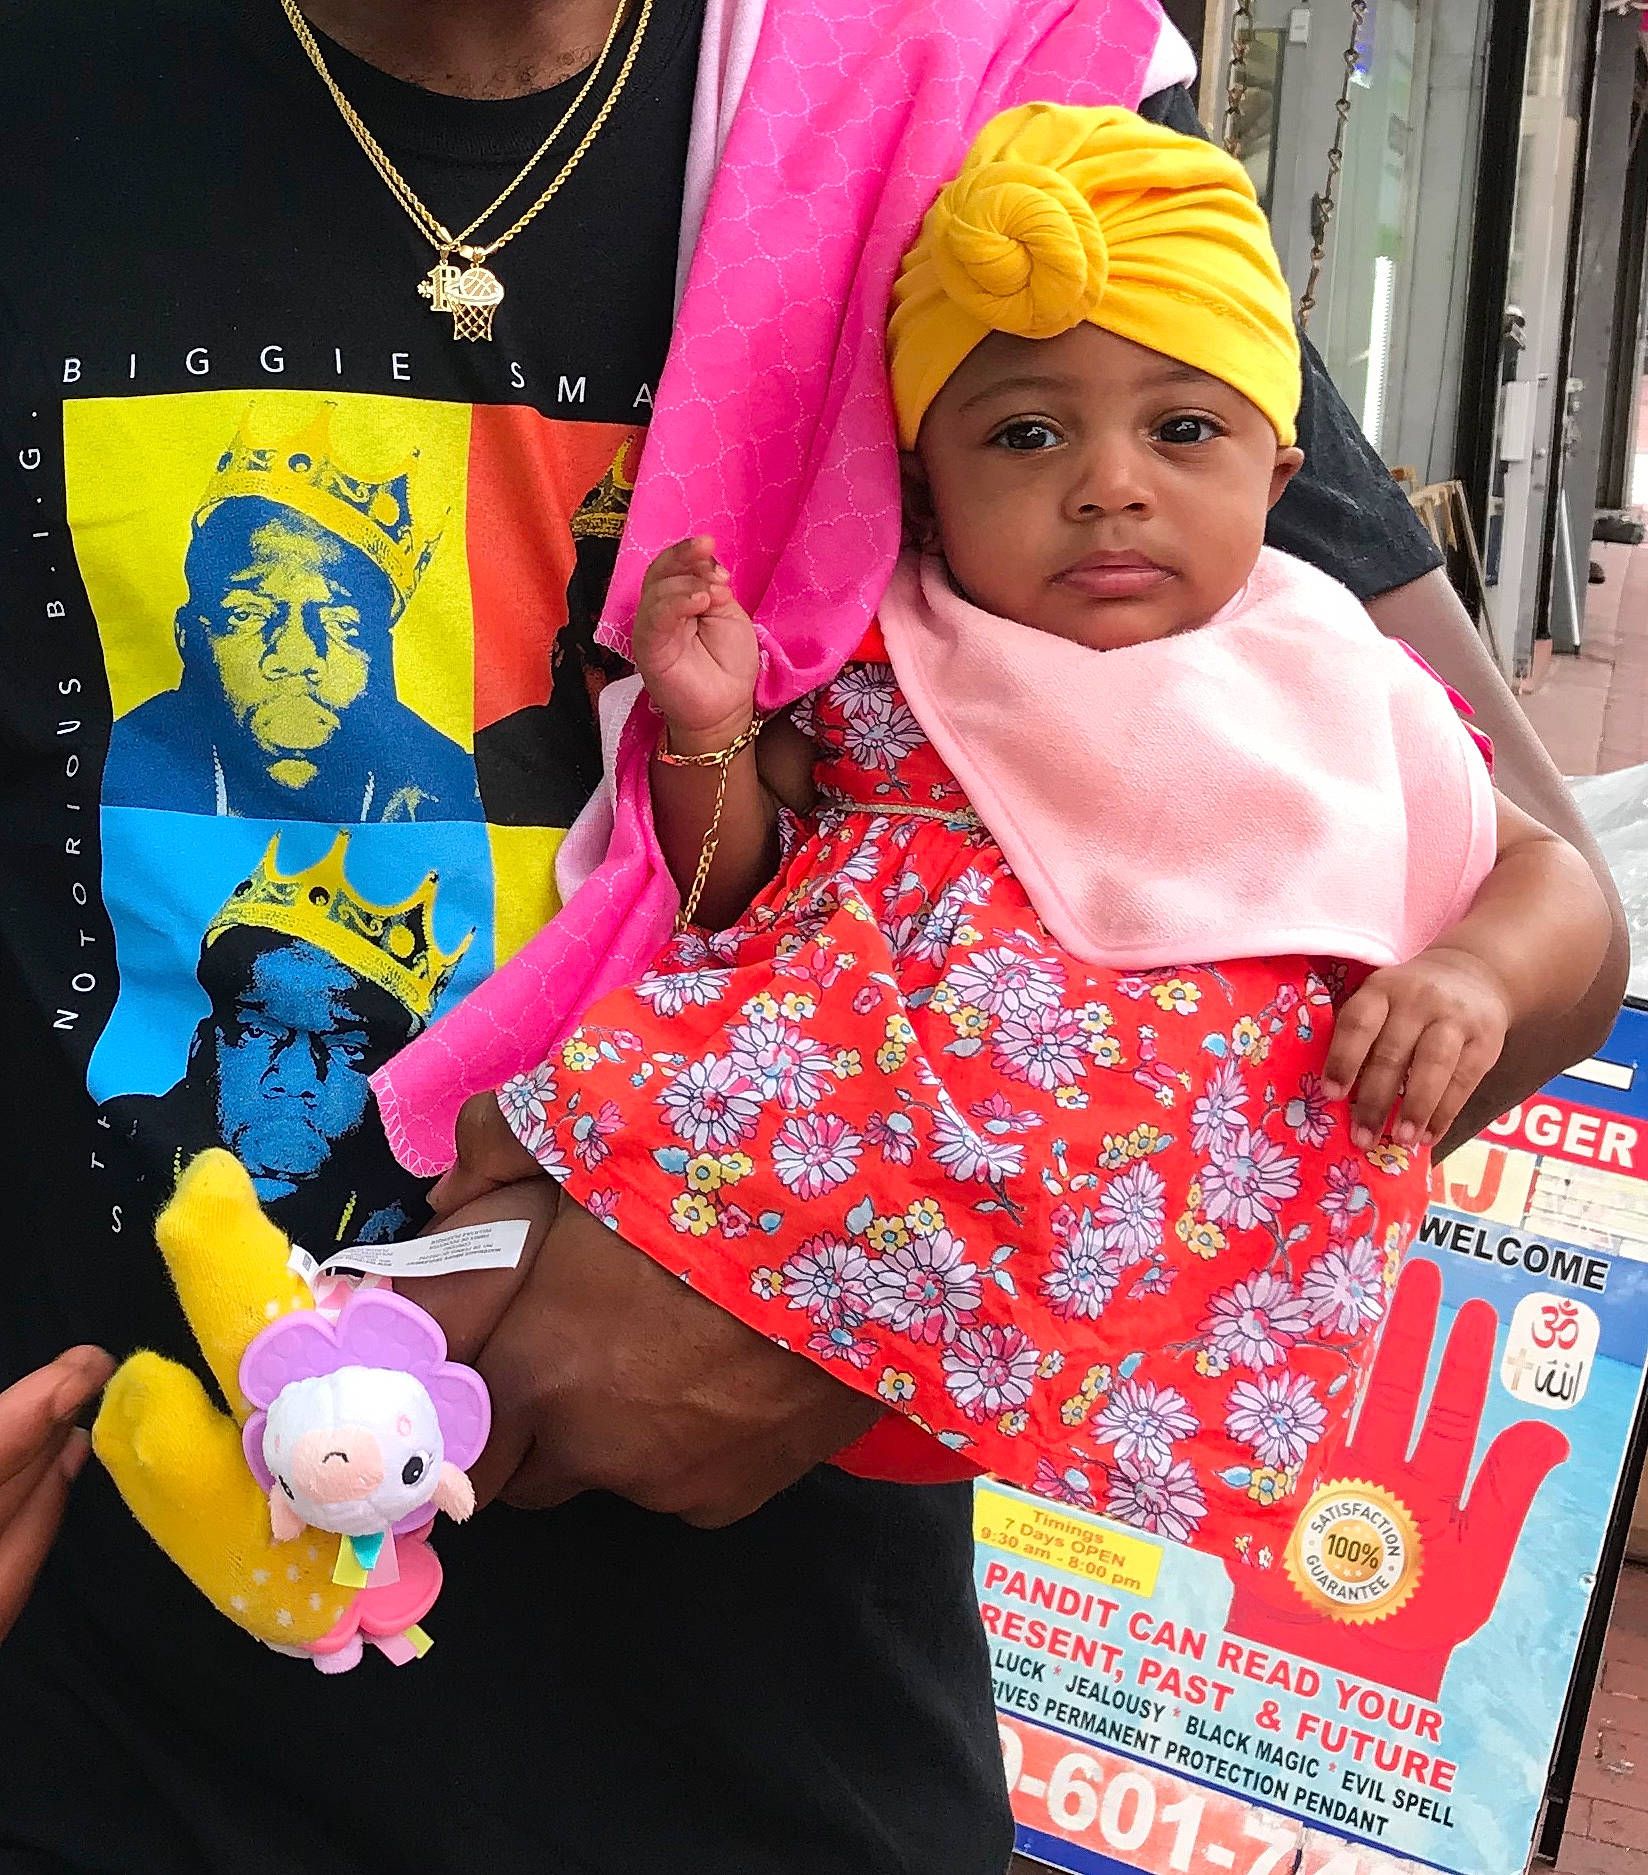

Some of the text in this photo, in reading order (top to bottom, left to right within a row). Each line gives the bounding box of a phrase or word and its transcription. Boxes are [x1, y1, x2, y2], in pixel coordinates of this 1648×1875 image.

[62, 344, 411, 383] BIGGIE
[52, 677, 97, 1030] NOTORIOUS
[1419, 1215, 1610, 1290] WELCOME
[1005, 1518, 1126, 1567] 7 Days OPEN
[1033, 1509, 1105, 1544] Timings
[1310, 1502, 1401, 1557] SATISFACTION
[1327, 1533, 1381, 1570] 100%
[1023, 1543, 1051, 1560] am
[1068, 1555, 1107, 1578] 8:00
[1111, 1573, 1141, 1590] pm
[1306, 1554, 1390, 1600] GUARANTEE
[983, 1561, 1443, 1742] PANDIT CAN READ YOUR
[995, 1648, 1454, 1828] LUCK JEALOUSY BLACK MAGIC EVIL SPELL
[1137, 1657, 1235, 1713] PAST
[1255, 1700, 1282, 1732] &
[1296, 1712, 1459, 1793] FUTURE
[1044, 1697, 1161, 1755] PERMANENT
[1164, 1740, 1290, 1802] PROTECTION
[1293, 1786, 1389, 1836] PENDANT
